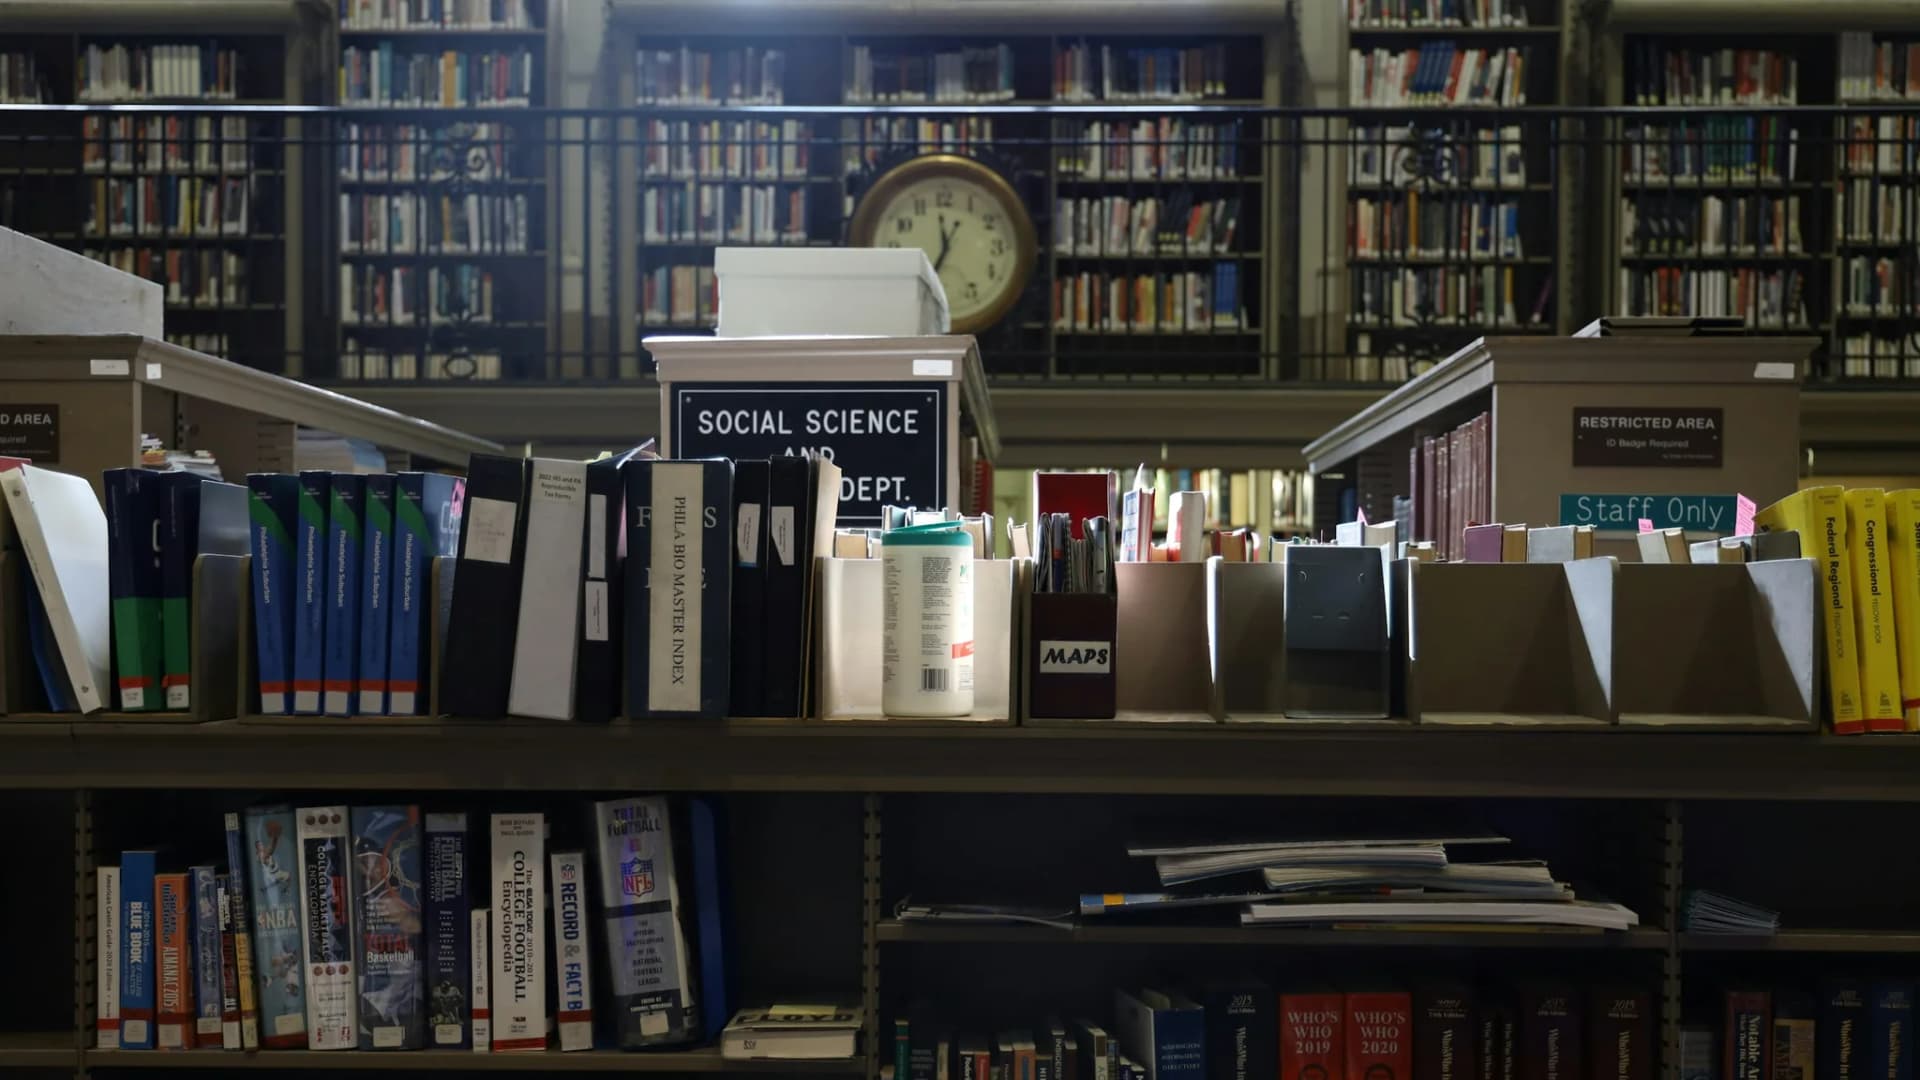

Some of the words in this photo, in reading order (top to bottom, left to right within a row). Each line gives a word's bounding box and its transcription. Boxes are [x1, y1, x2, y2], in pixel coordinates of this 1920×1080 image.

[914, 199, 926, 216] 11
[936, 192, 953, 208] 12
[967, 195, 974, 212] 1
[897, 217, 912, 233] 10
[14, 413, 52, 425] AREA
[697, 409, 793, 435] SOCIAL
[804, 408, 920, 435] SCIENCE
[1580, 416, 1672, 429] RESTRICTED
[1676, 417, 1716, 429] AREA
[1606, 439, 1616, 448] ID
[1619, 439, 1647, 449] Badge
[1649, 439, 1689, 449] Required
[839, 476, 912, 502] DEPT.
[674, 496, 687, 540] PHILA
[1576, 496, 1655, 522] Staff
[1667, 497, 1724, 530] Only
[260, 527, 270, 569] Philadelphia
[306, 526, 316, 568] Philadelphia
[337, 530, 346, 572] Philadelphia
[373, 531, 382, 573] Philadelphia
[1826, 517, 1839, 558] Federal
[404, 533, 414, 576] Philadelphia
[674, 544, 686, 570] BIO
[1865, 520, 1881, 596] Congressional
[262, 570, 272, 603] Suburban
[306, 569, 315, 603] Suburban
[337, 574, 346, 607] Suburban
[372, 574, 381, 608] Suburban
[403, 577, 412, 611] Suburban
[1828, 561, 1843, 609] Regional
[672, 573, 686, 633] MASTER
[672, 638, 685, 685] INDEX
[1042, 647, 1108, 665] MAPS
[317, 846, 327, 890] COLLEGE
[441, 836, 456, 902] FOOTBALL
[526, 869, 534, 884] The
[623, 873, 654, 893] NFL
[513, 851, 526, 919] COLLEGE
[130, 901, 142, 931] BLUE
[307, 864, 318, 939] ENCYCLOPEDIA
[526, 894, 534, 909] USA
[560, 882, 579, 941] RECORD
[266, 909, 297, 929] NBA
[500, 880, 513, 973] Encyclopedia
[526, 911, 534, 934] TODAY
[130, 932, 142, 964] BOOK
[367, 951, 414, 963] Basketball
[514, 923, 527, 1003] FOOTBALL
[564, 944, 581, 958] &
[161, 946, 180, 987] ALMANAC
[565, 963, 582, 998] FACT
[162, 988, 179, 1007] 2015
[1287, 1010, 1339, 1024] WHO'S
[1294, 1025, 1332, 1038] WHO
[1353, 1010, 1406, 1024] WHO'S
[1360, 1025, 1400, 1038] WHO
[1295, 1041, 1331, 1054] 2019
[1360, 1041, 1398, 1054] 2020
[1748, 1014, 1761, 1062] Notable
